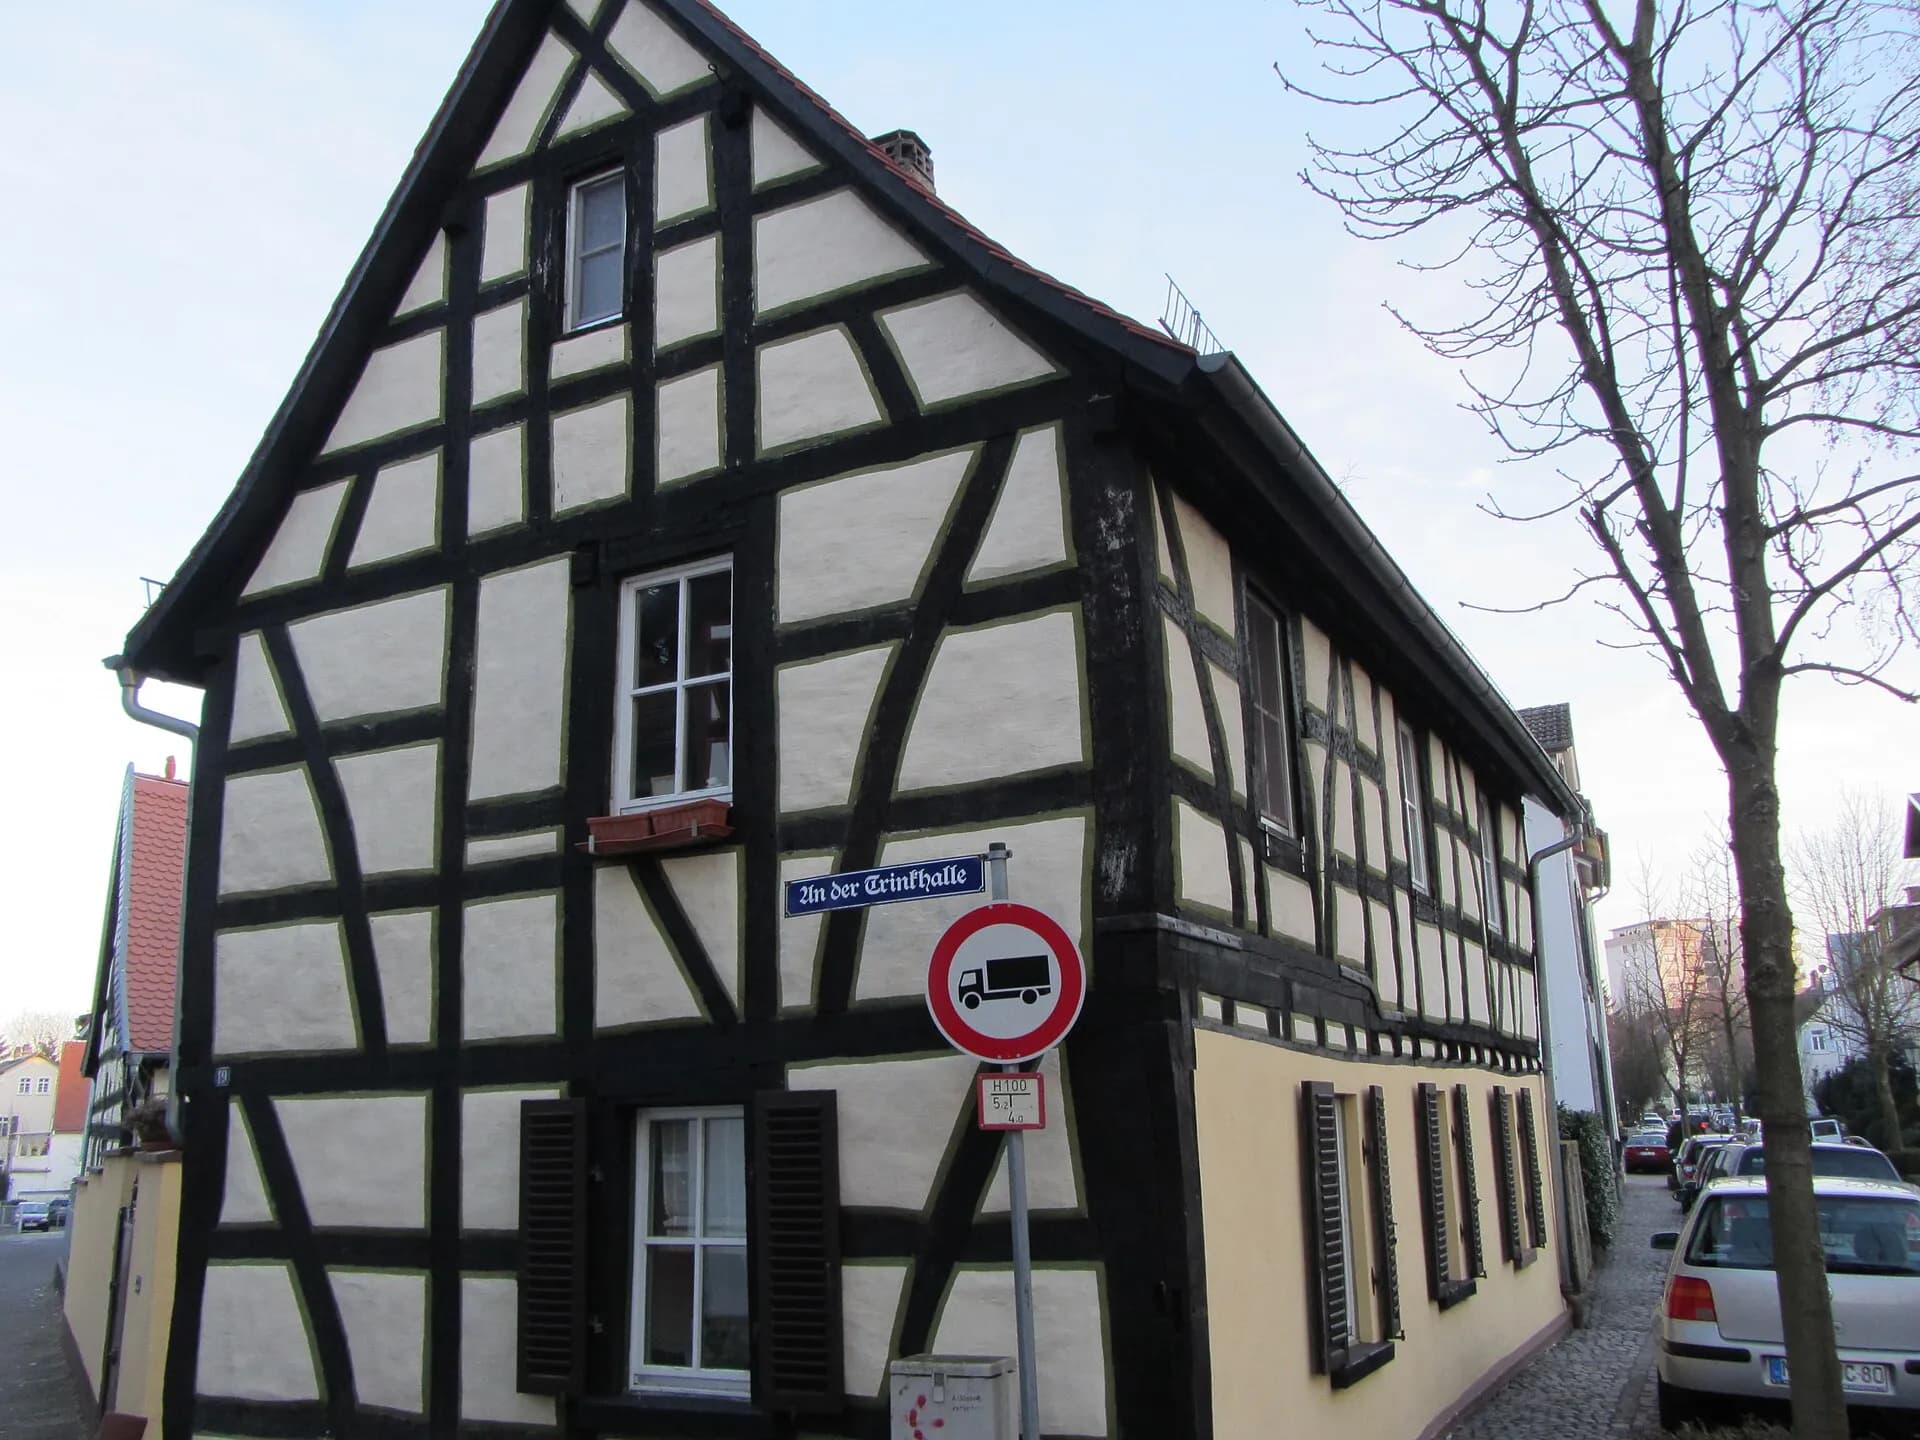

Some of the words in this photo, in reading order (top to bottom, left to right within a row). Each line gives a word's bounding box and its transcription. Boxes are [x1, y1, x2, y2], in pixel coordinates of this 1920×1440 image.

[799, 884, 826, 905] An
[830, 880, 860, 901] der
[864, 864, 967, 895] Trinkhalle
